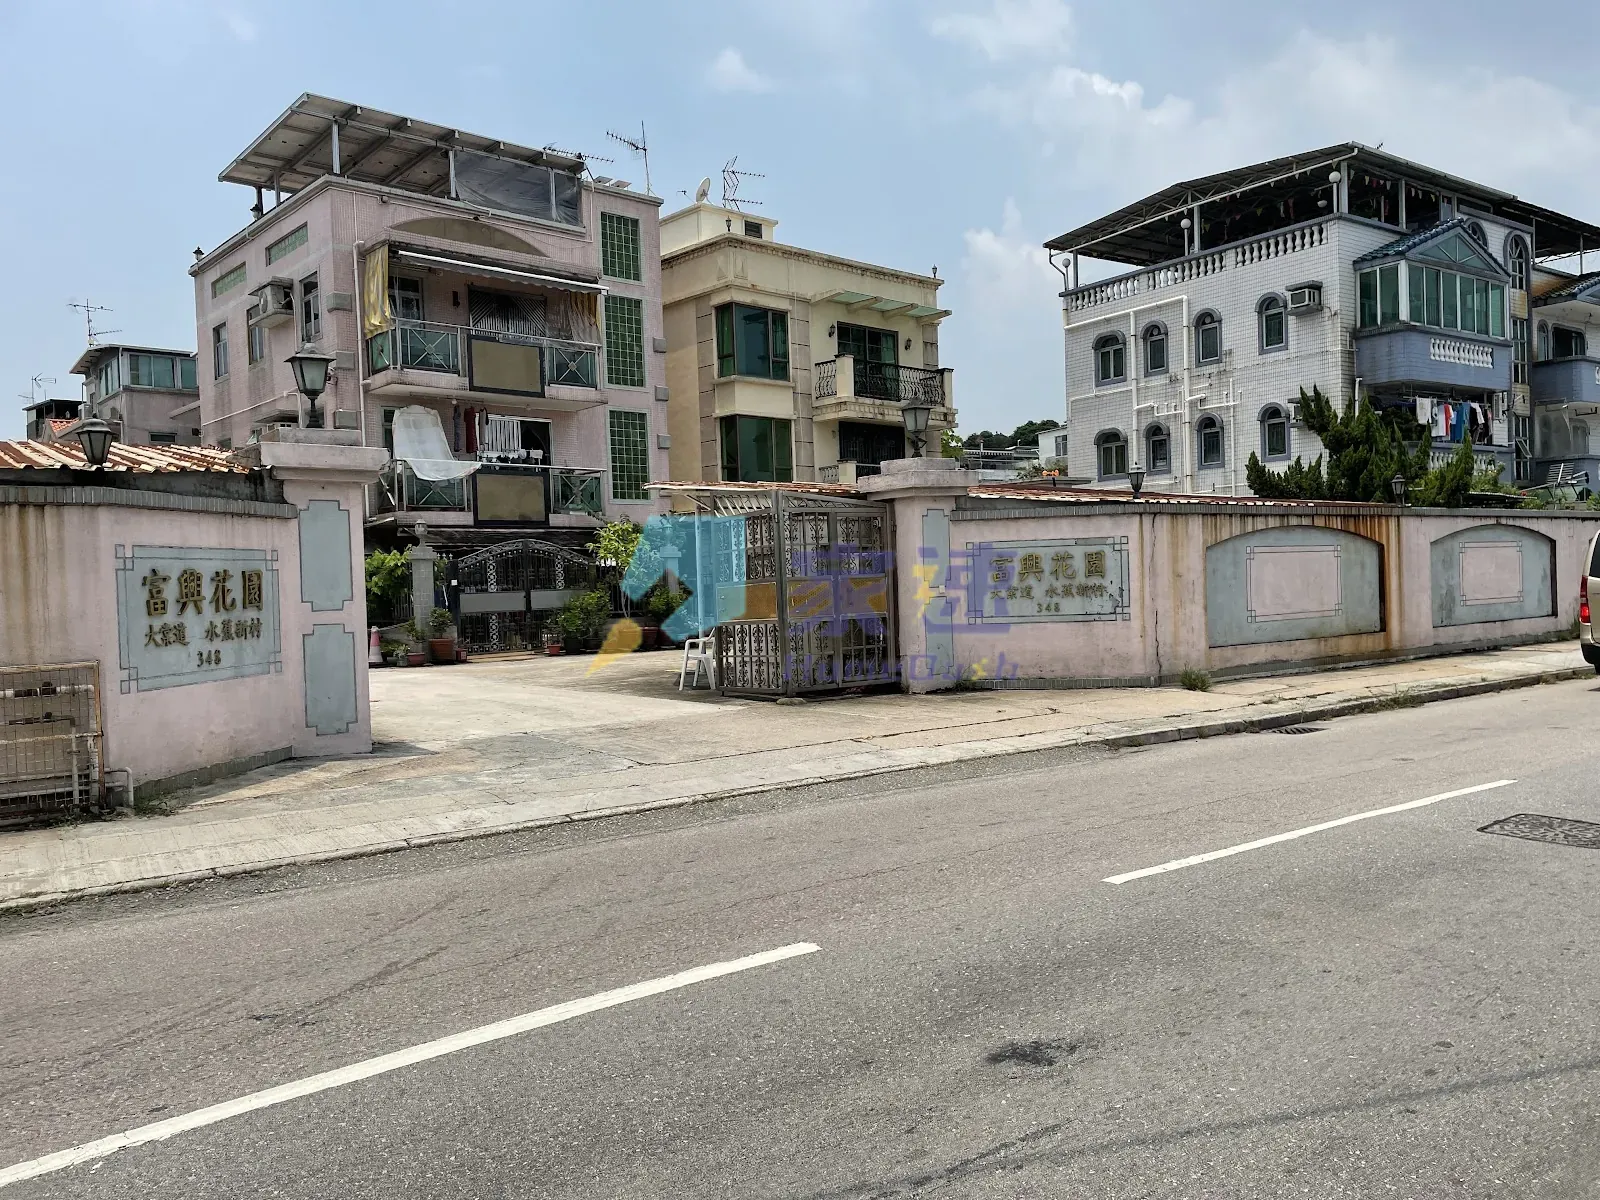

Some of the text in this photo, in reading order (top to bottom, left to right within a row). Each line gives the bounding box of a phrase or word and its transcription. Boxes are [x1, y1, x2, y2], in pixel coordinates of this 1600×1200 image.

[989, 550, 1106, 582] 富興花園
[141, 568, 264, 616] 富興花園
[1036, 602, 1061, 613] 348
[144, 618, 263, 647] 大棠道 水蕉新村
[196, 649, 222, 668] 348
